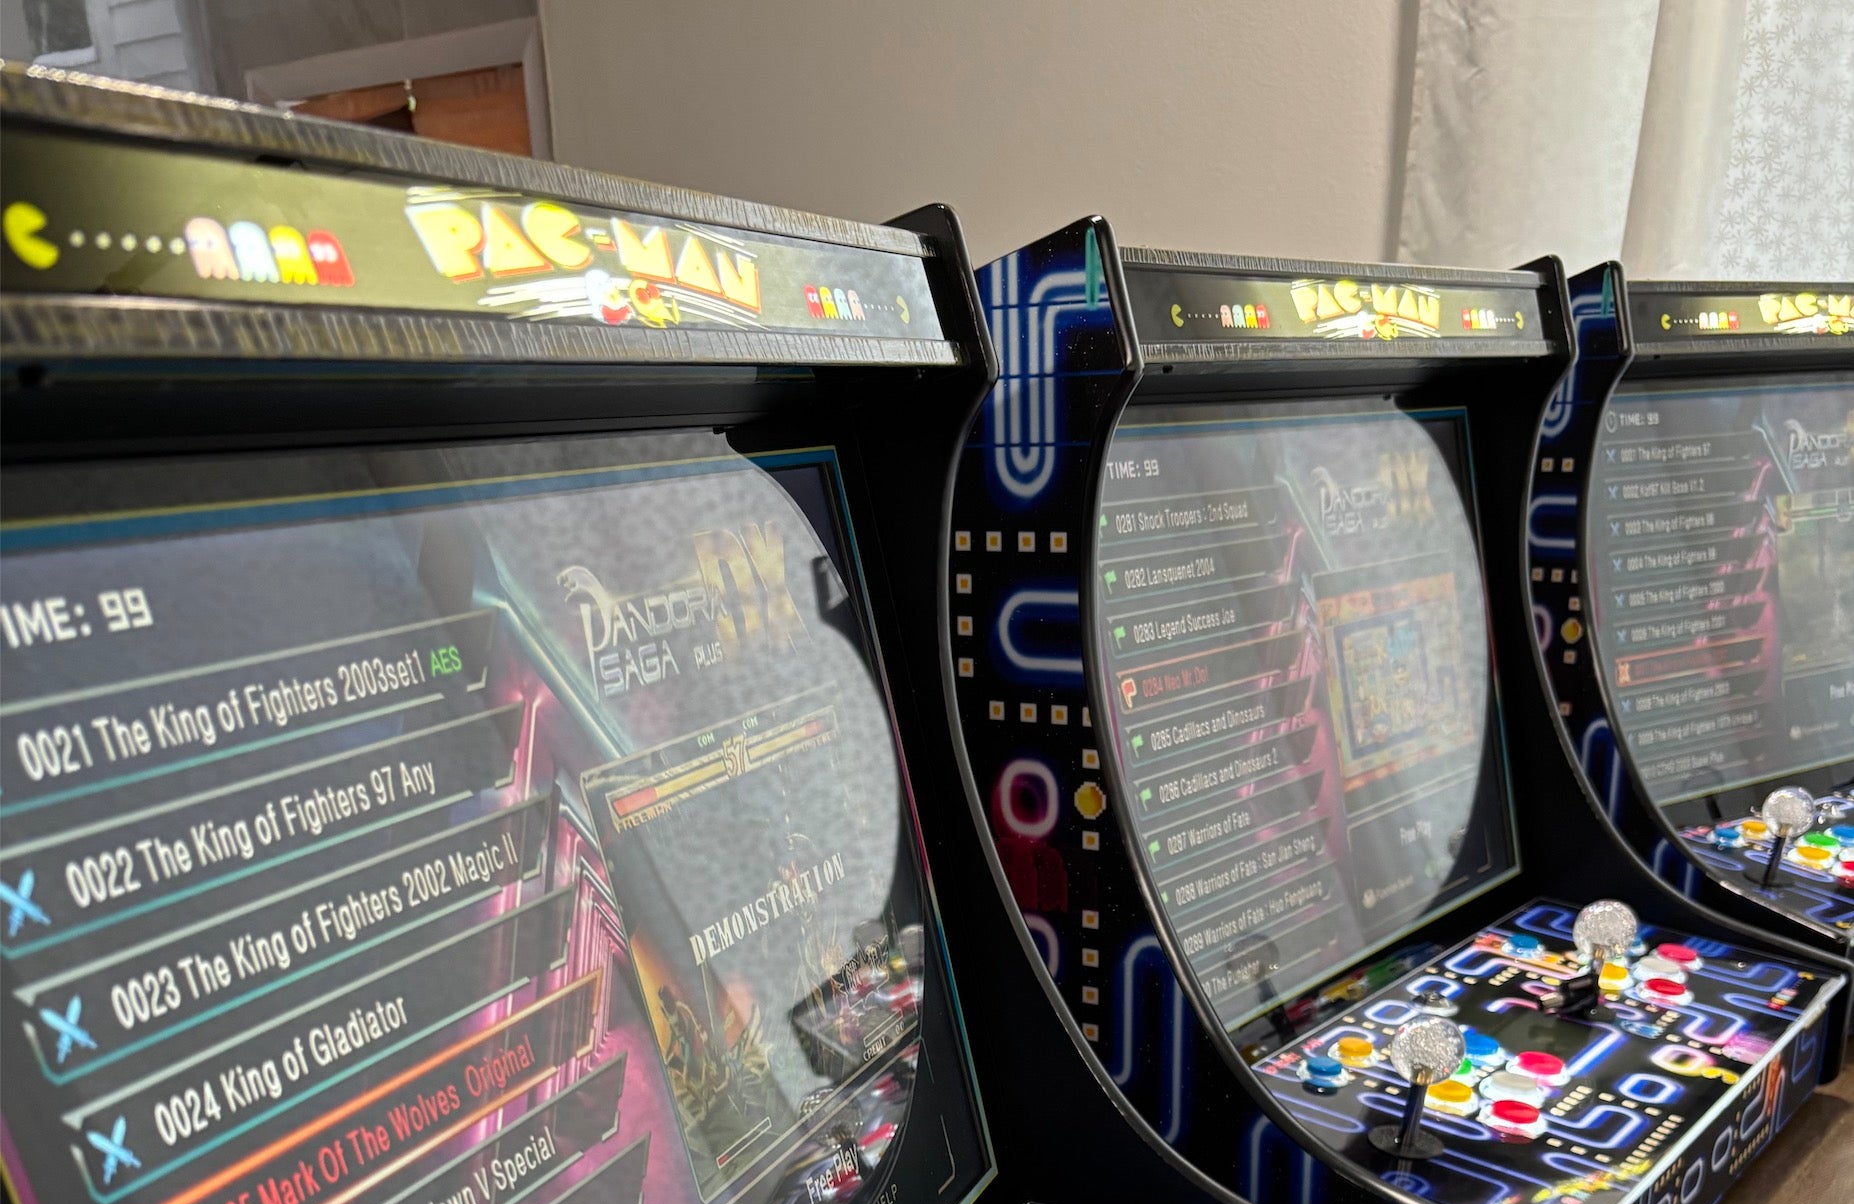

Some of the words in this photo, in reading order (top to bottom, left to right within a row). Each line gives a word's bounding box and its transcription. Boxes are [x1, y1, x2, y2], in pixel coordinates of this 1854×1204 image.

[406, 202, 762, 314] PAC-MAN
[1290, 280, 1440, 330] PAC-MAN
[1758, 292, 1854, 324] PAC-M
[1107, 460, 1141, 480] TIME:
[1143, 459, 1160, 477] 99
[1115, 513, 1137, 534] 0281
[1137, 510, 1164, 532] Shock
[1164, 508, 1202, 530] Troopers
[1207, 503, 1223, 522] 2nd
[1222, 501, 1248, 522] Squad
[0, 597, 91, 648] IME:
[97, 587, 153, 632] 99
[1133, 622, 1156, 644] 0283
[1155, 616, 1187, 641] Legend
[1186, 614, 1221, 634] Success
[1221, 608, 1236, 626] Joe
[599, 639, 680, 698] SAGA
[693, 641, 724, 670] PLUS
[18, 723, 93, 781] 0021
[91, 715, 151, 762] The
[150, 702, 216, 748] King
[216, 689, 244, 732] of
[242, 677, 338, 726] Fighters
[337, 650, 426, 701] 2003set1
[430, 646, 463, 677] AES
[1150, 727, 1172, 752] 0285
[1171, 720, 1211, 745] Cadillacs
[1211, 712, 1227, 731] and
[1226, 704, 1266, 728] Dinosaurs
[1180, 771, 1219, 797] Cadillacs
[1218, 767, 1235, 784] and
[1234, 752, 1272, 779] Dinosaurs
[65, 847, 141, 908] 0022
[135, 838, 193, 883] The
[190, 820, 255, 867] King
[254, 802, 281, 845] of
[280, 781, 371, 836] Fighters
[370, 766, 395, 806] 97
[399, 761, 436, 803] Any
[1187, 822, 1223, 846] Warriors
[1222, 814, 1232, 832] of
[1231, 811, 1251, 830] Fate
[1196, 872, 1231, 895] Warriors
[689, 851, 846, 967] DEMONSTRATION
[1203, 920, 1237, 946] Warriors
[111, 966, 181, 1030] 0023
[177, 954, 231, 999] The
[229, 934, 290, 980] King
[290, 911, 317, 953] of
[315, 886, 403, 943] Fighters
[402, 859, 451, 908] 2002
[449, 841, 504, 888] Magic
[154, 1080, 222, 1146] 0024
[219, 1059, 282, 1113] King
[281, 1037, 309, 1082] of
[308, 996, 407, 1067] Gladiator
[863, 1035, 887, 1062] CREDIT
[317, 1140, 349, 1183] Of
[346, 1122, 390, 1165] The
[387, 1084, 461, 1142] Wolves
[464, 1033, 536, 1098] Original
[473, 1166, 492, 1201] V
[490, 1125, 557, 1191] Special
[832, 1144, 860, 1182] Play
